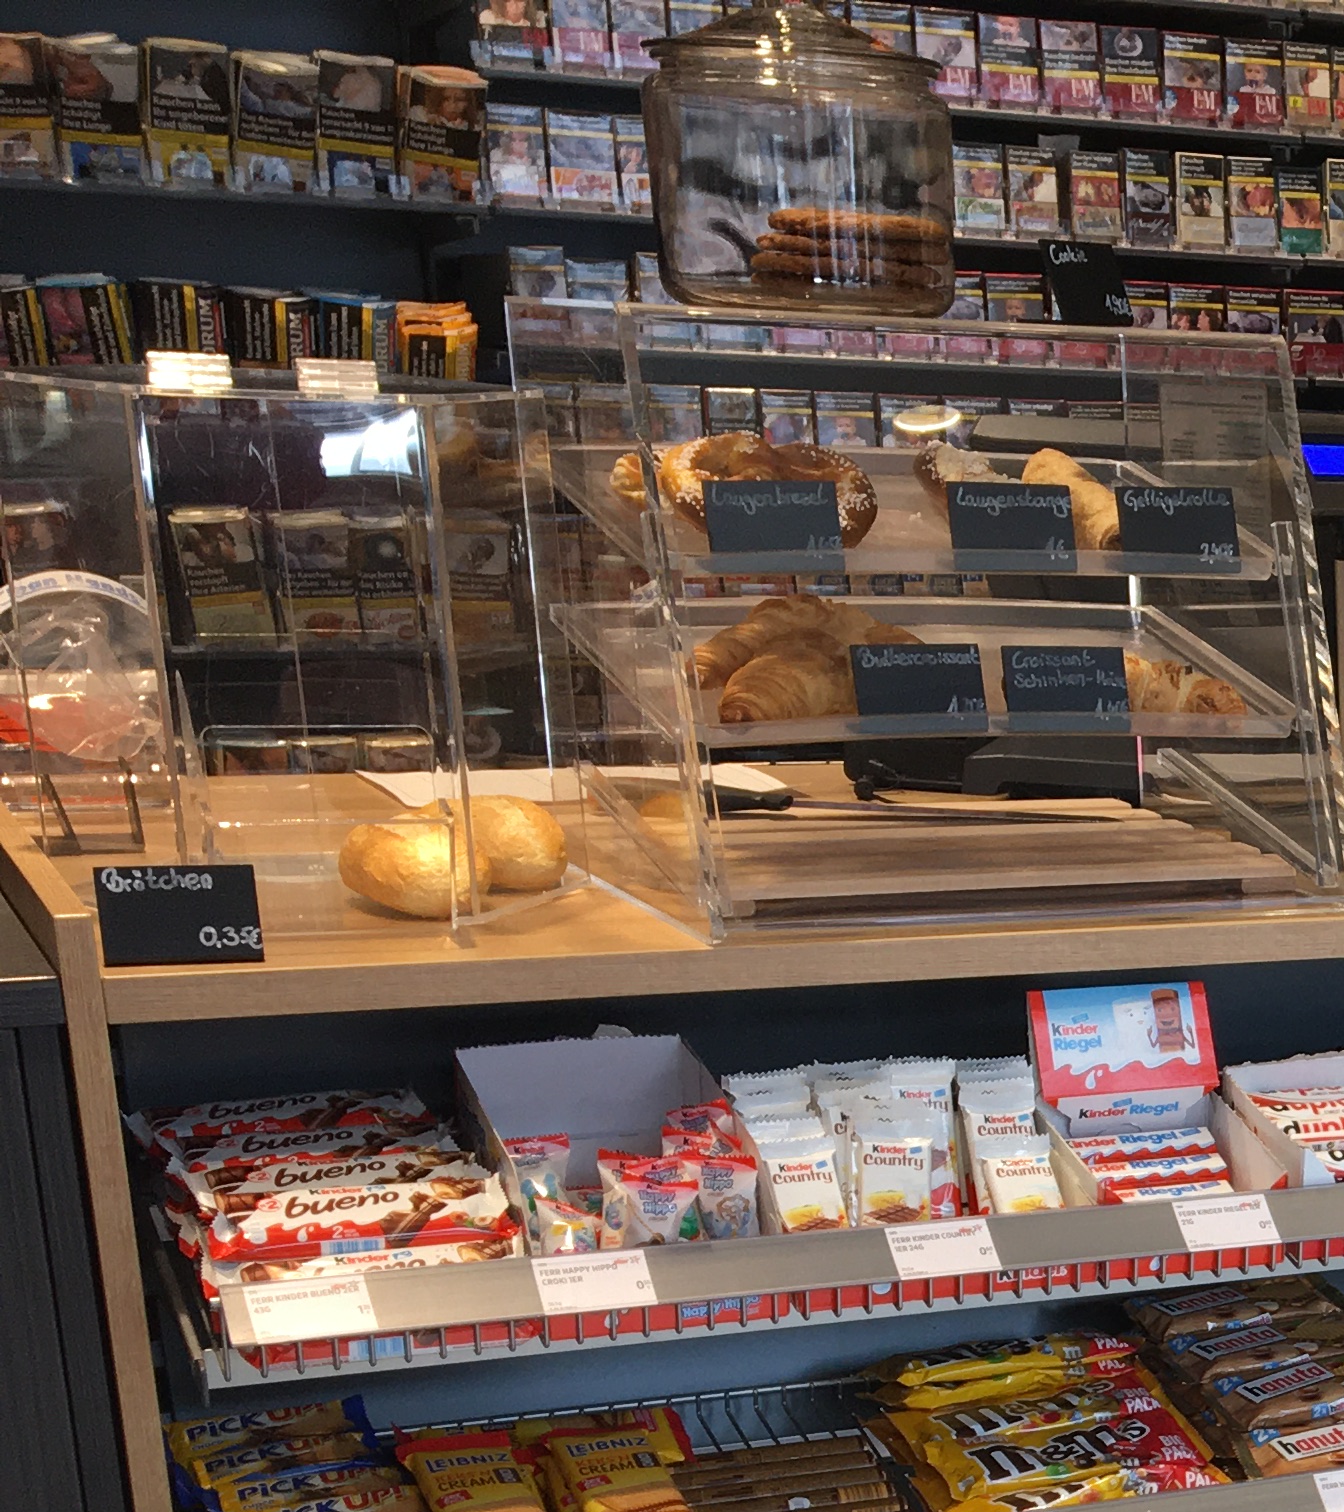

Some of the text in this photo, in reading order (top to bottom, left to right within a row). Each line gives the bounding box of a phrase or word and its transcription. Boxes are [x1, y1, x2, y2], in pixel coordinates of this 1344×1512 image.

[1048, 244, 1089, 265] Cookie
[955, 486, 1073, 517] Laugenstange
[1011, 650, 1096, 669] Croissant
[101, 866, 213, 893] Brötchen
[1053, 1033, 1102, 1052] Riegel
[1129, 1098, 1180, 1117] Riegel
[862, 1152, 926, 1172] Country
[274, 1158, 387, 1188] bueno
[772, 1169, 834, 1186] Country
[284, 1188, 400, 1218] bueno
[562, 1266, 591, 1276] HAPPY
[592, 1263, 618, 1273] HIPPO
[565, 1436, 649, 1458] LEIBNIZ
[425, 1451, 510, 1474] LEIBNIZ
[437, 1474, 497, 1492] CREAM
